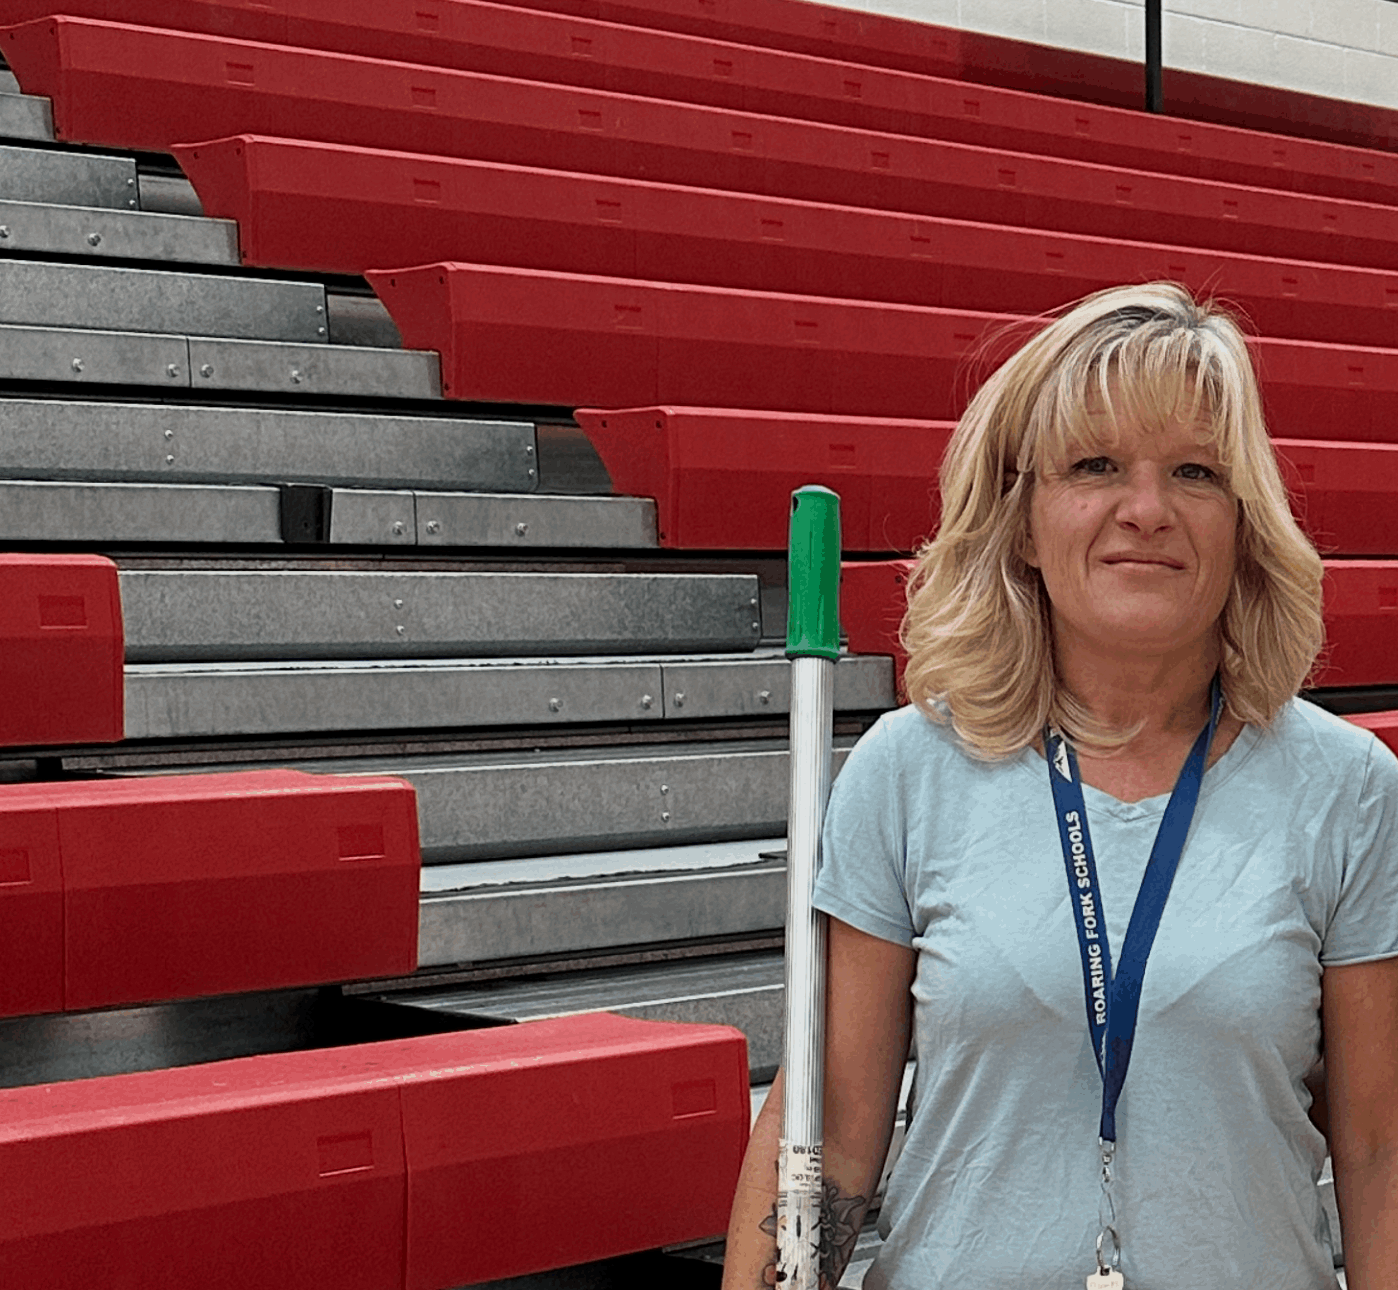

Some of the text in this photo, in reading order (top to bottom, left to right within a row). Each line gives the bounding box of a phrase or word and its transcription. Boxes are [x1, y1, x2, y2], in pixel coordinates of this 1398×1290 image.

[1066, 810, 1106, 1026] ROARING FORK SCHOOLS
